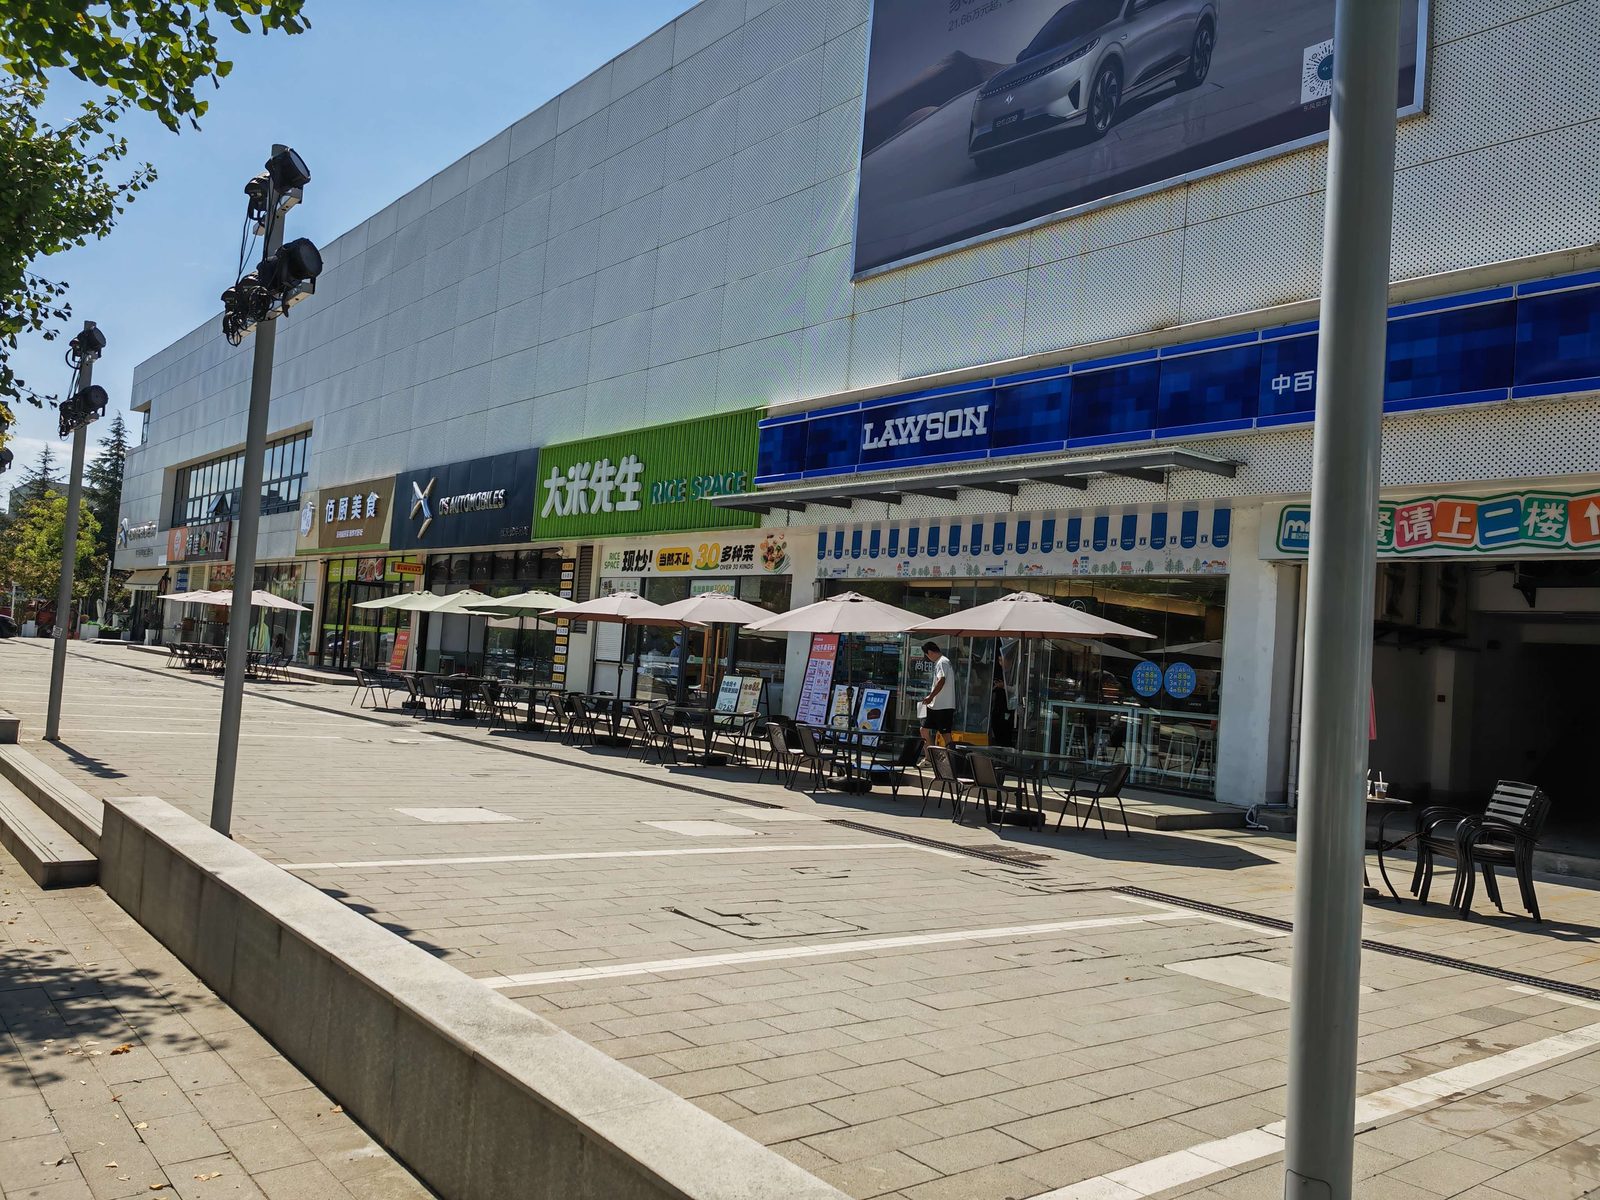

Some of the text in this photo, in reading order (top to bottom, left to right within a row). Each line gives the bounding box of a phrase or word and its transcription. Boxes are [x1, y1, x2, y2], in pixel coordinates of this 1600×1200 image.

[1271, 370, 1315, 395] 中百
[862, 404, 989, 450] LAWSON
[449, 488, 506, 514] AUTOMOBILES
[541, 454, 645, 519] 大米先生
[651, 470, 747, 505] RICE SPACE
[325, 491, 380, 524] 佰厨美食
[604, 560, 620, 570] SPACE
[608, 551, 621, 561] RICE
[621, 542, 756, 572] 现炒! 当然不止 30 多种菜
